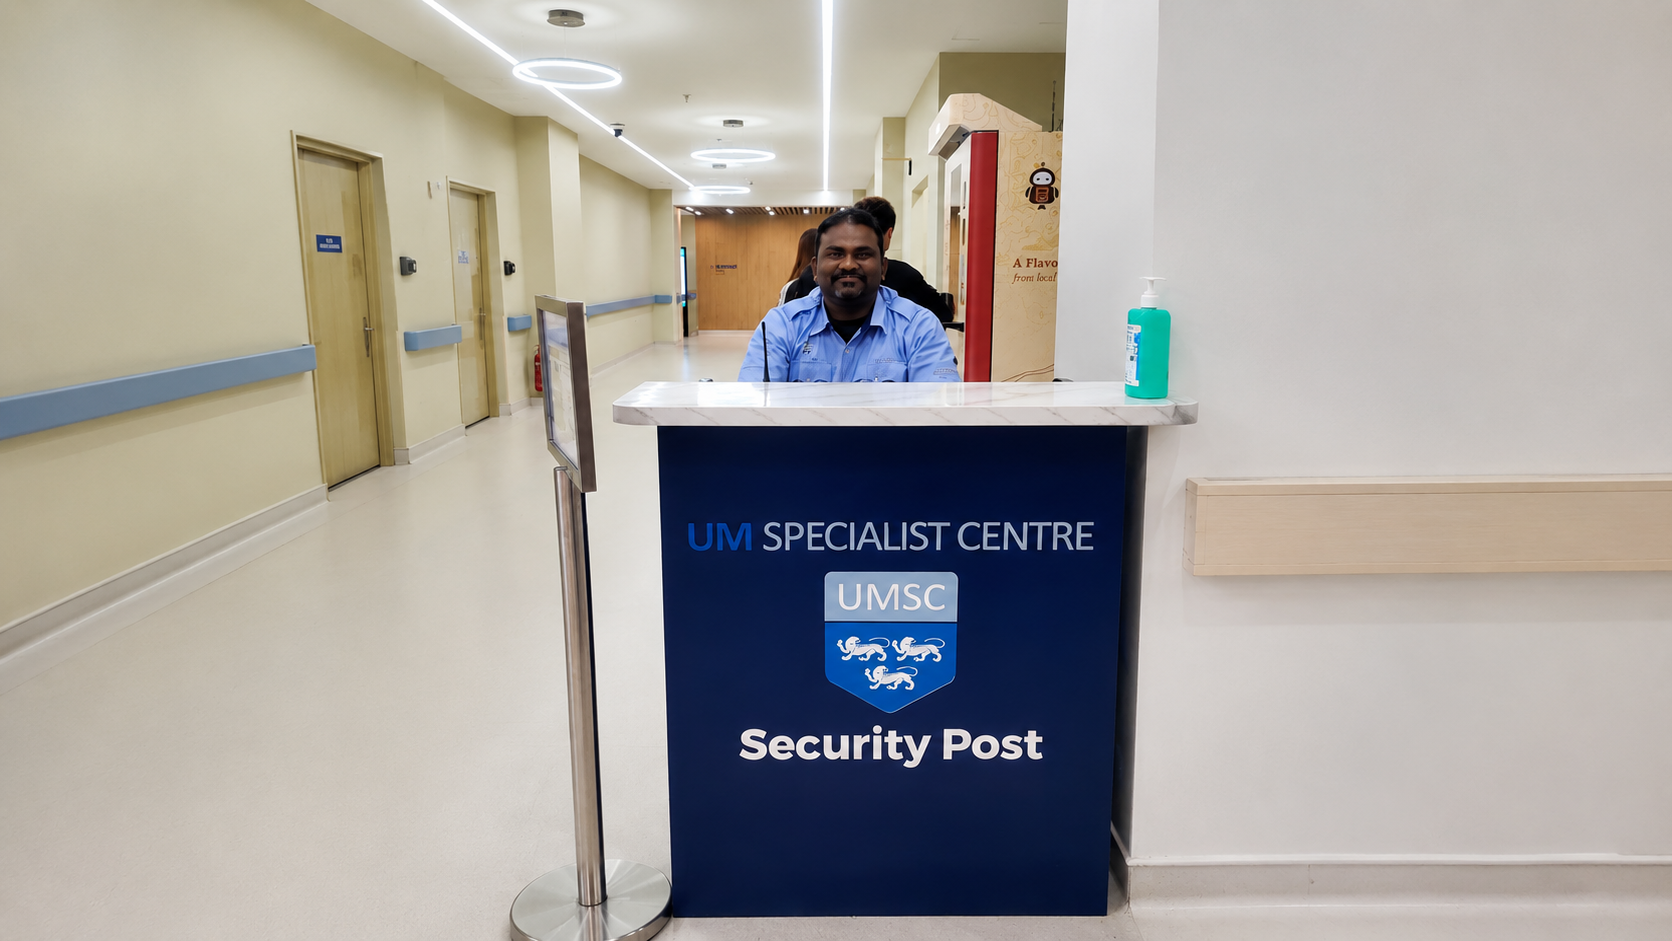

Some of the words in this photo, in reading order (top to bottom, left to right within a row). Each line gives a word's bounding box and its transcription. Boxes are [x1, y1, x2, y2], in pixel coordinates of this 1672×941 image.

[1012, 258, 1022, 268] A
[1037, 272, 1057, 282] local
[688, 522, 752, 551] UM
[762, 521, 951, 551] SPECIALIST
[957, 521, 1095, 551] CENTRE
[838, 583, 946, 611] UMSC
[739, 725, 932, 769] Security
[943, 729, 1043, 761] Post
